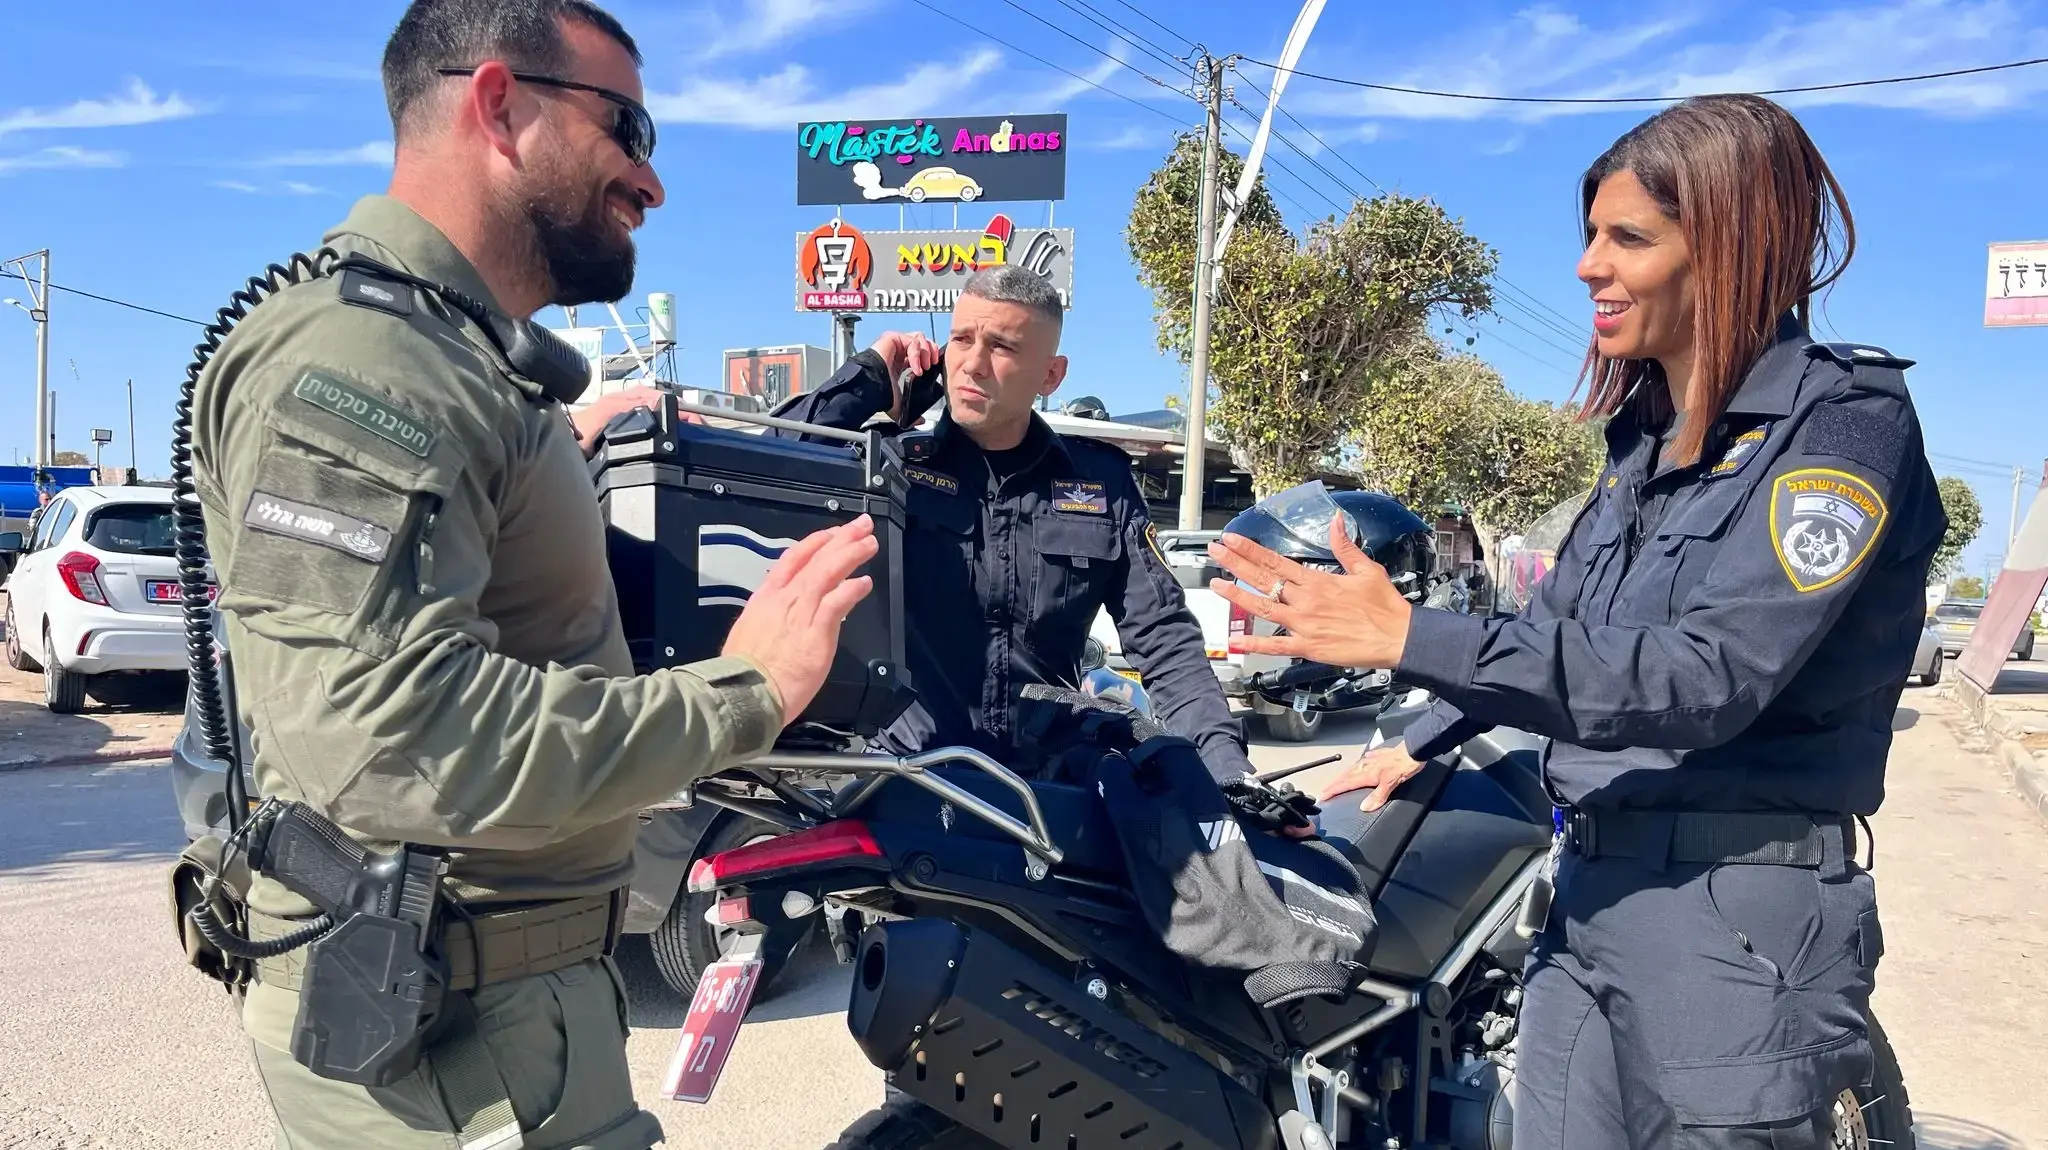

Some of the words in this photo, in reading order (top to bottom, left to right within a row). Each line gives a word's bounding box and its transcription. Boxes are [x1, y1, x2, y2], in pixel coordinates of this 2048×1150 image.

[897, 235, 1007, 272] באשא
[807, 294, 863, 306] AL-BASHA
[303, 378, 369, 415] טקטית
[369, 408, 428, 448] חטיבה
[1786, 479, 1836, 492] ישראל
[1835, 484, 1879, 519] משטרת
